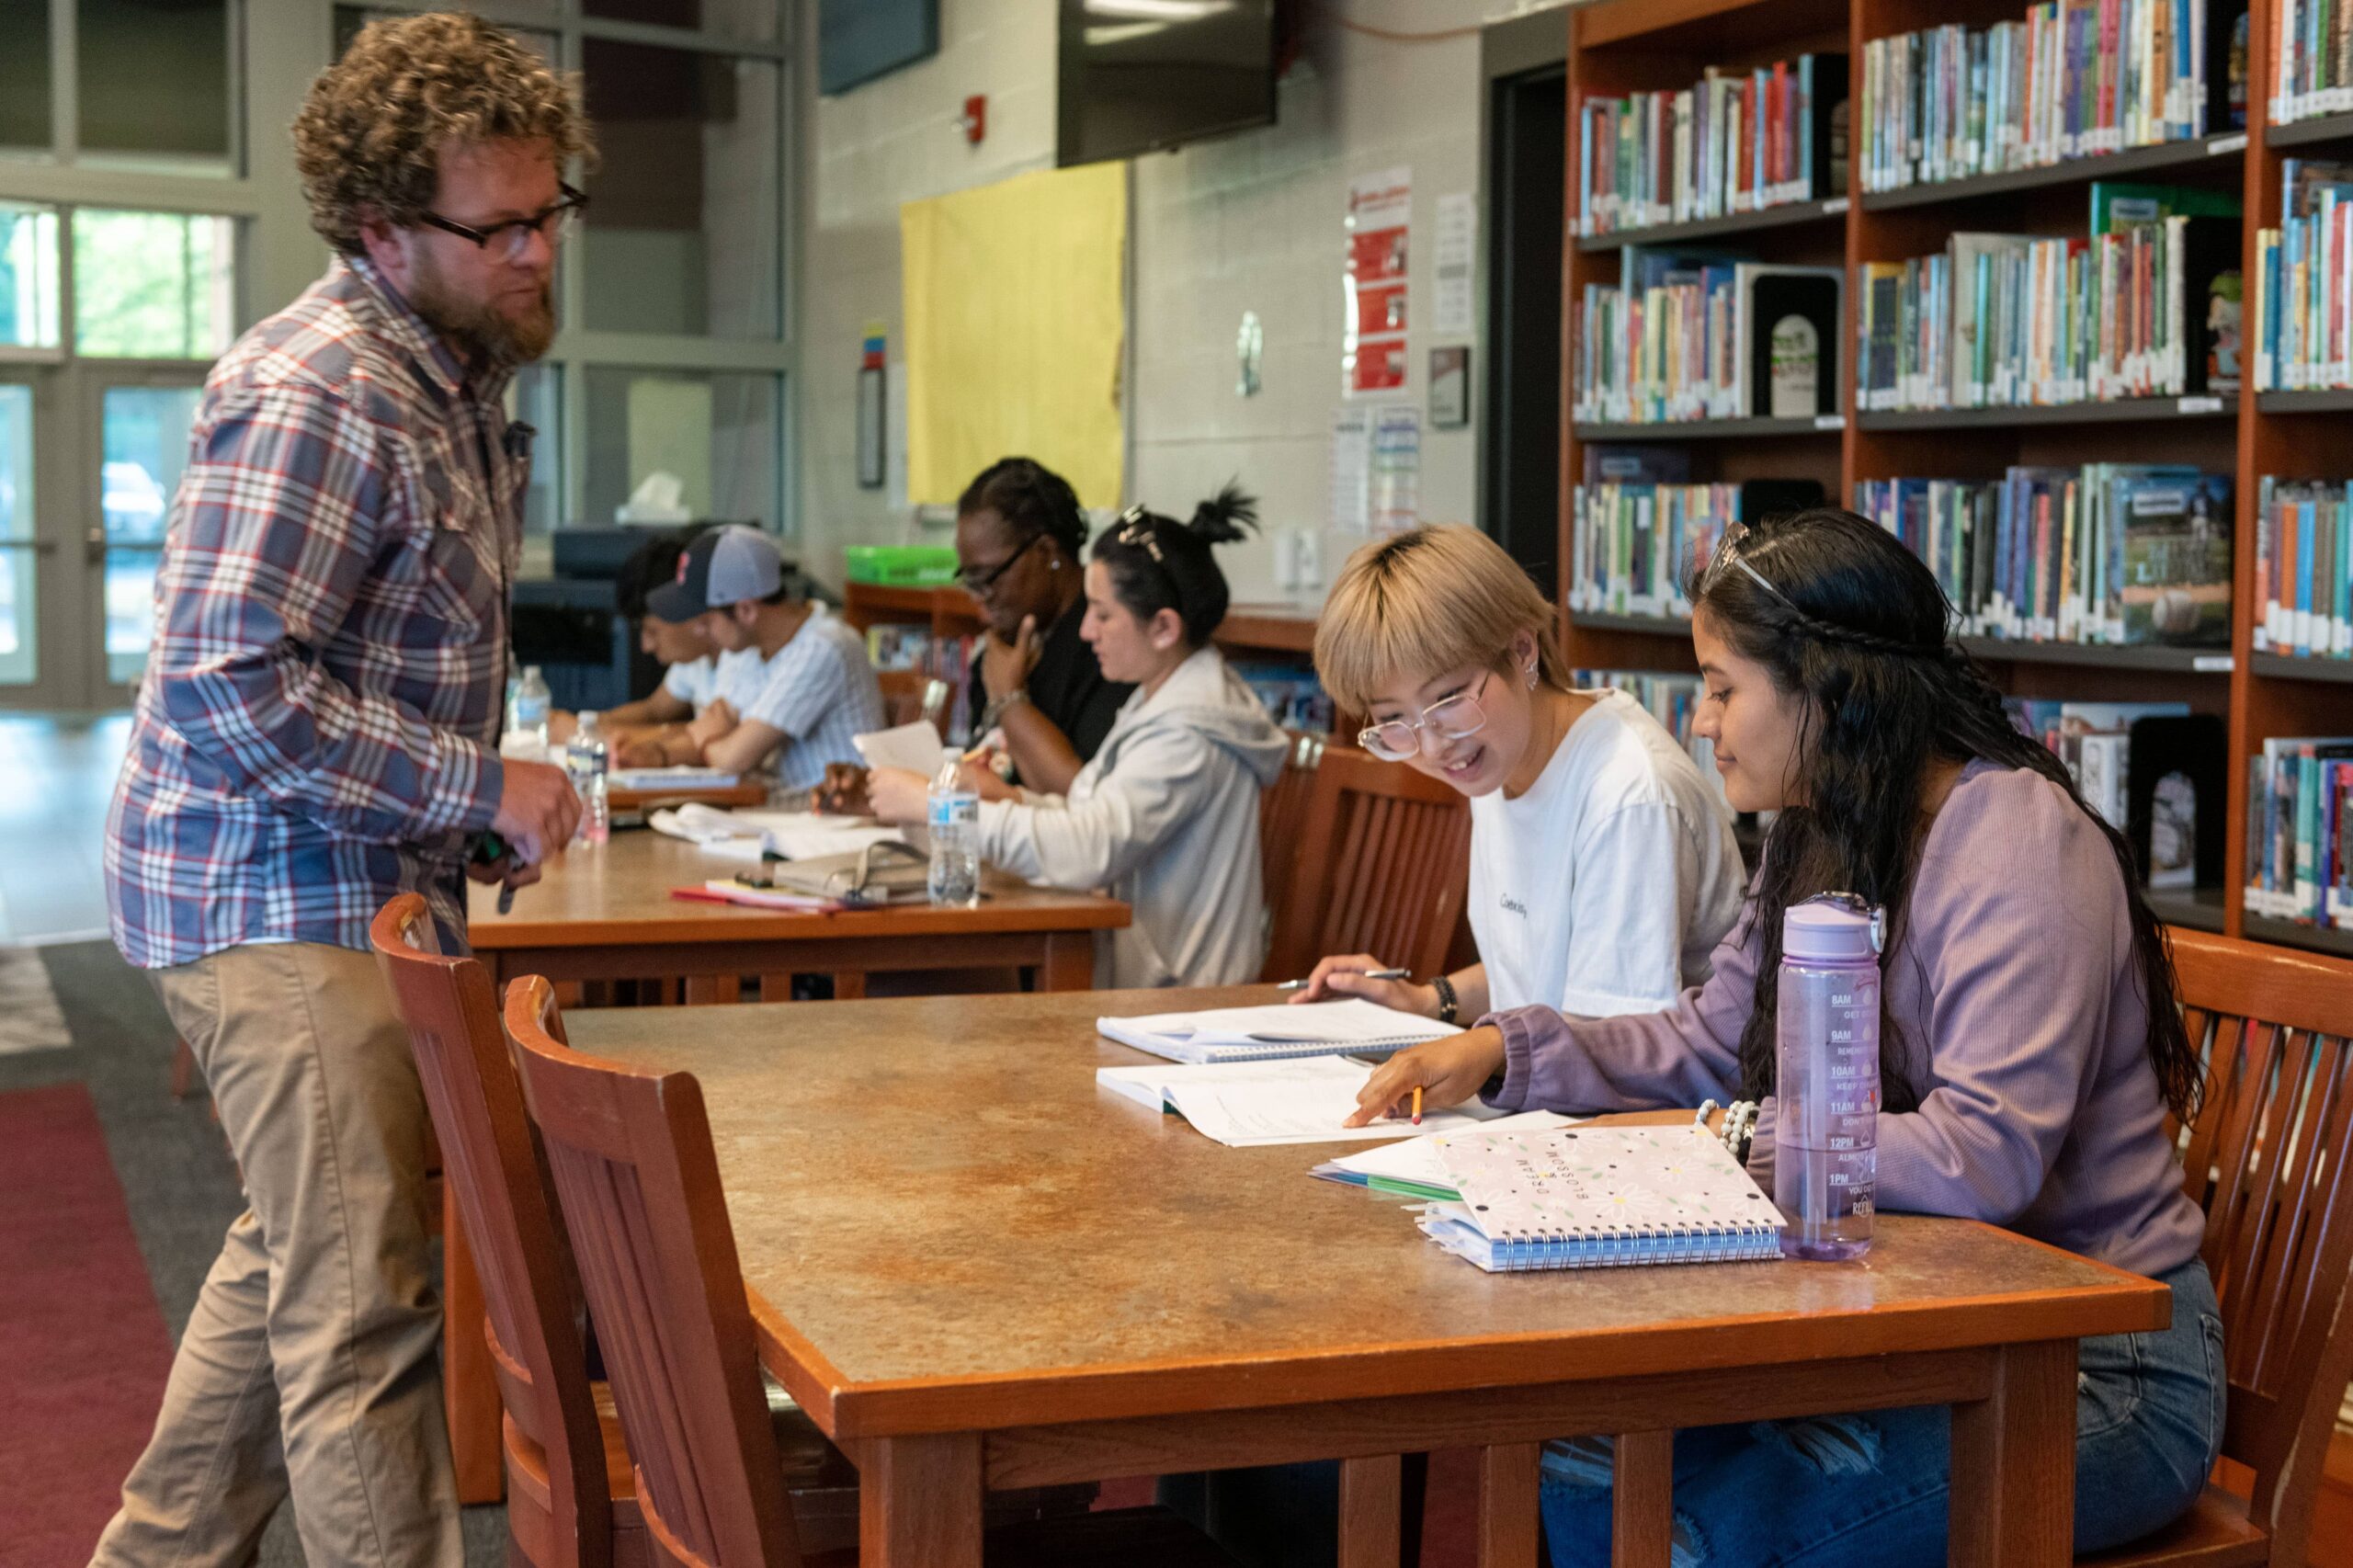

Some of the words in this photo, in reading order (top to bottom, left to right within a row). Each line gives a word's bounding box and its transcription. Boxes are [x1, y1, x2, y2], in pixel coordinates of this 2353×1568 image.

[1831, 994, 1851, 1005] 8AM
[1831, 1029, 1851, 1040] 9AM
[1831, 1066, 1855, 1076] 10AM
[1830, 1102, 1855, 1112] 11AM
[1830, 1137, 1854, 1148] 12PM
[1545, 1152, 1589, 1199] BLOSSOM
[1830, 1173, 1848, 1184] 1PM
[1848, 1187, 1862, 1195] YOU
